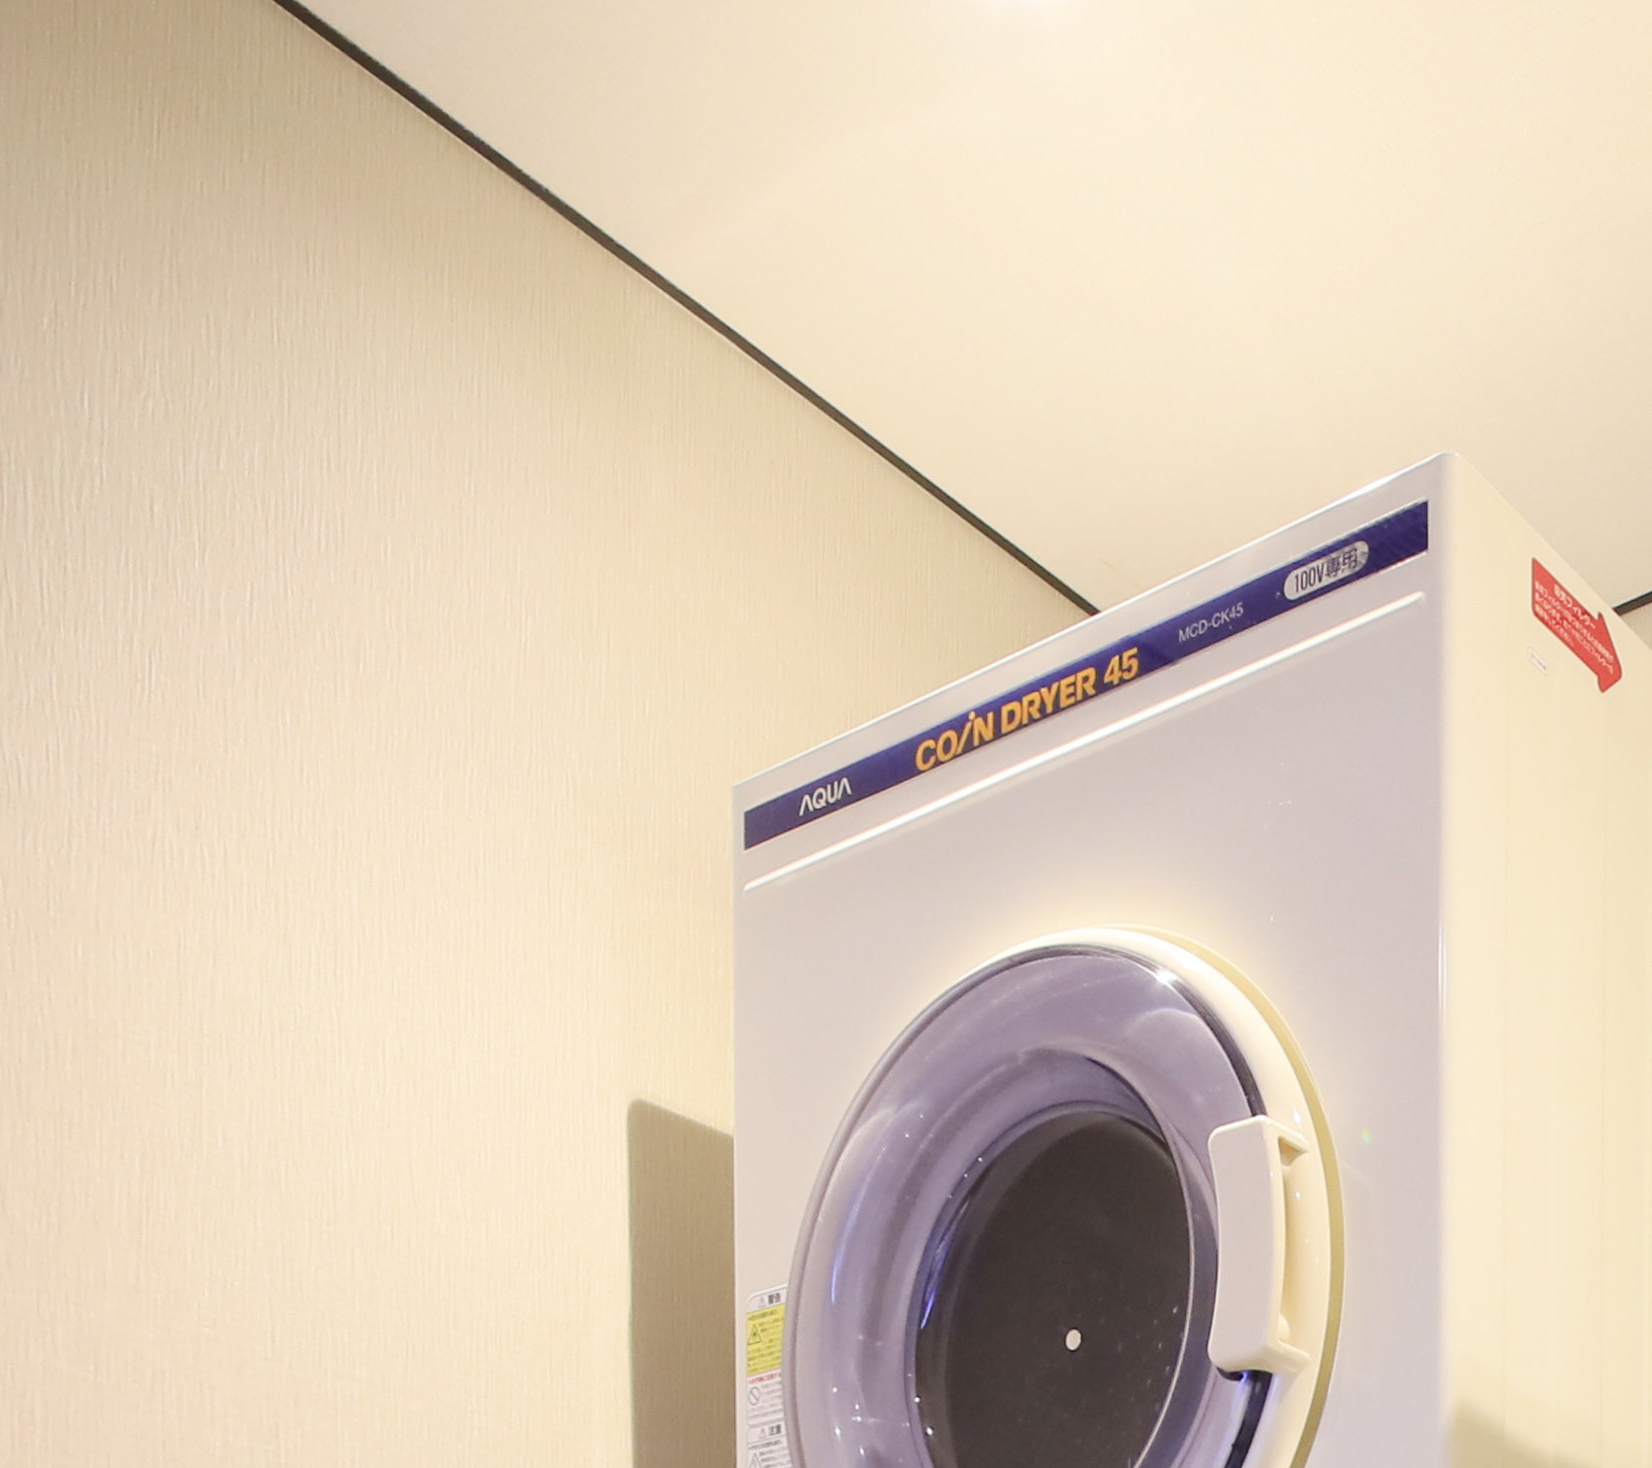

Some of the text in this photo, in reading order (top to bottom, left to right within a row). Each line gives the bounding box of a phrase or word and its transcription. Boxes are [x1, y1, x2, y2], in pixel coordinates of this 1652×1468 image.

[1293, 546, 1358, 593] 100V専用
[799, 601, 1245, 816] AQUA COIN DRYER 45 MCD-CK45
